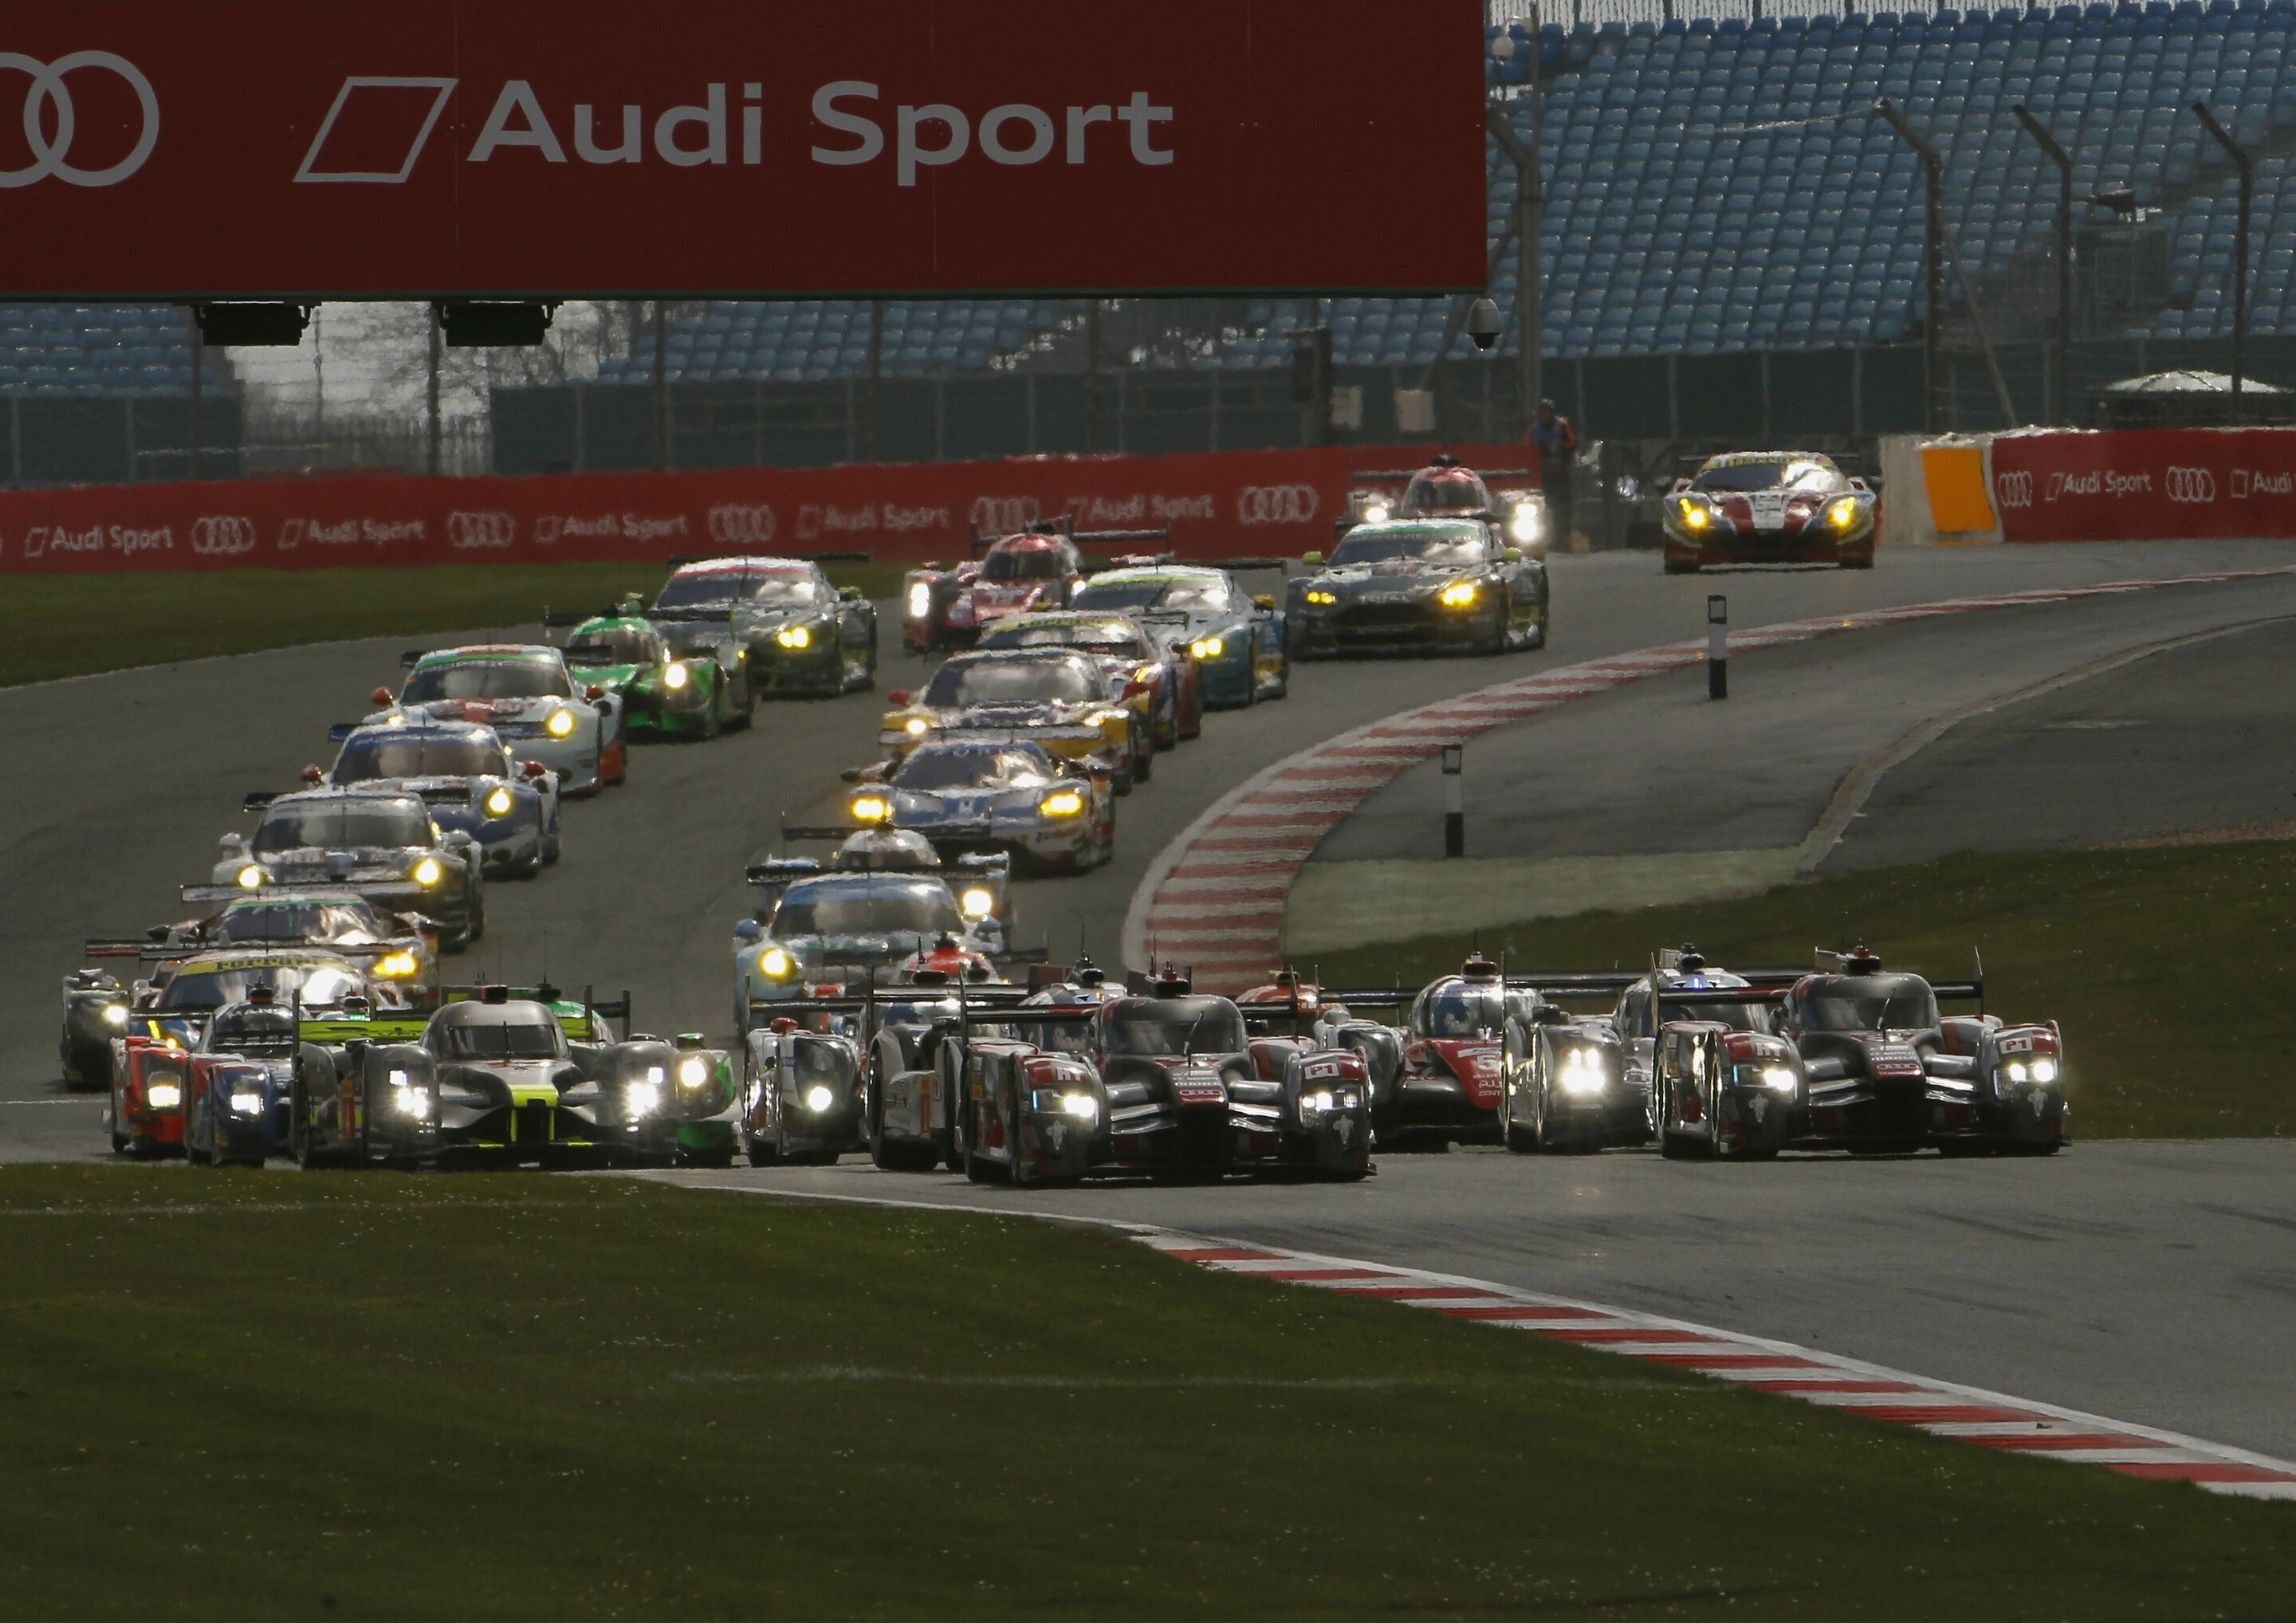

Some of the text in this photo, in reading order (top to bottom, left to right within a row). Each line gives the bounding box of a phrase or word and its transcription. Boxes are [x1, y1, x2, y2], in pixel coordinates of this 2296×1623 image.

[466, 80, 1174, 187] Audi Sport
[2063, 470, 2152, 497] Audi Sport
[2253, 472, 2292, 493] Audi
[1090, 494, 1144, 521] Audi
[50, 525, 173, 555] Audi Sport
[2005, 1039, 2027, 1051] P1
[1311, 1064, 1333, 1075] P1
